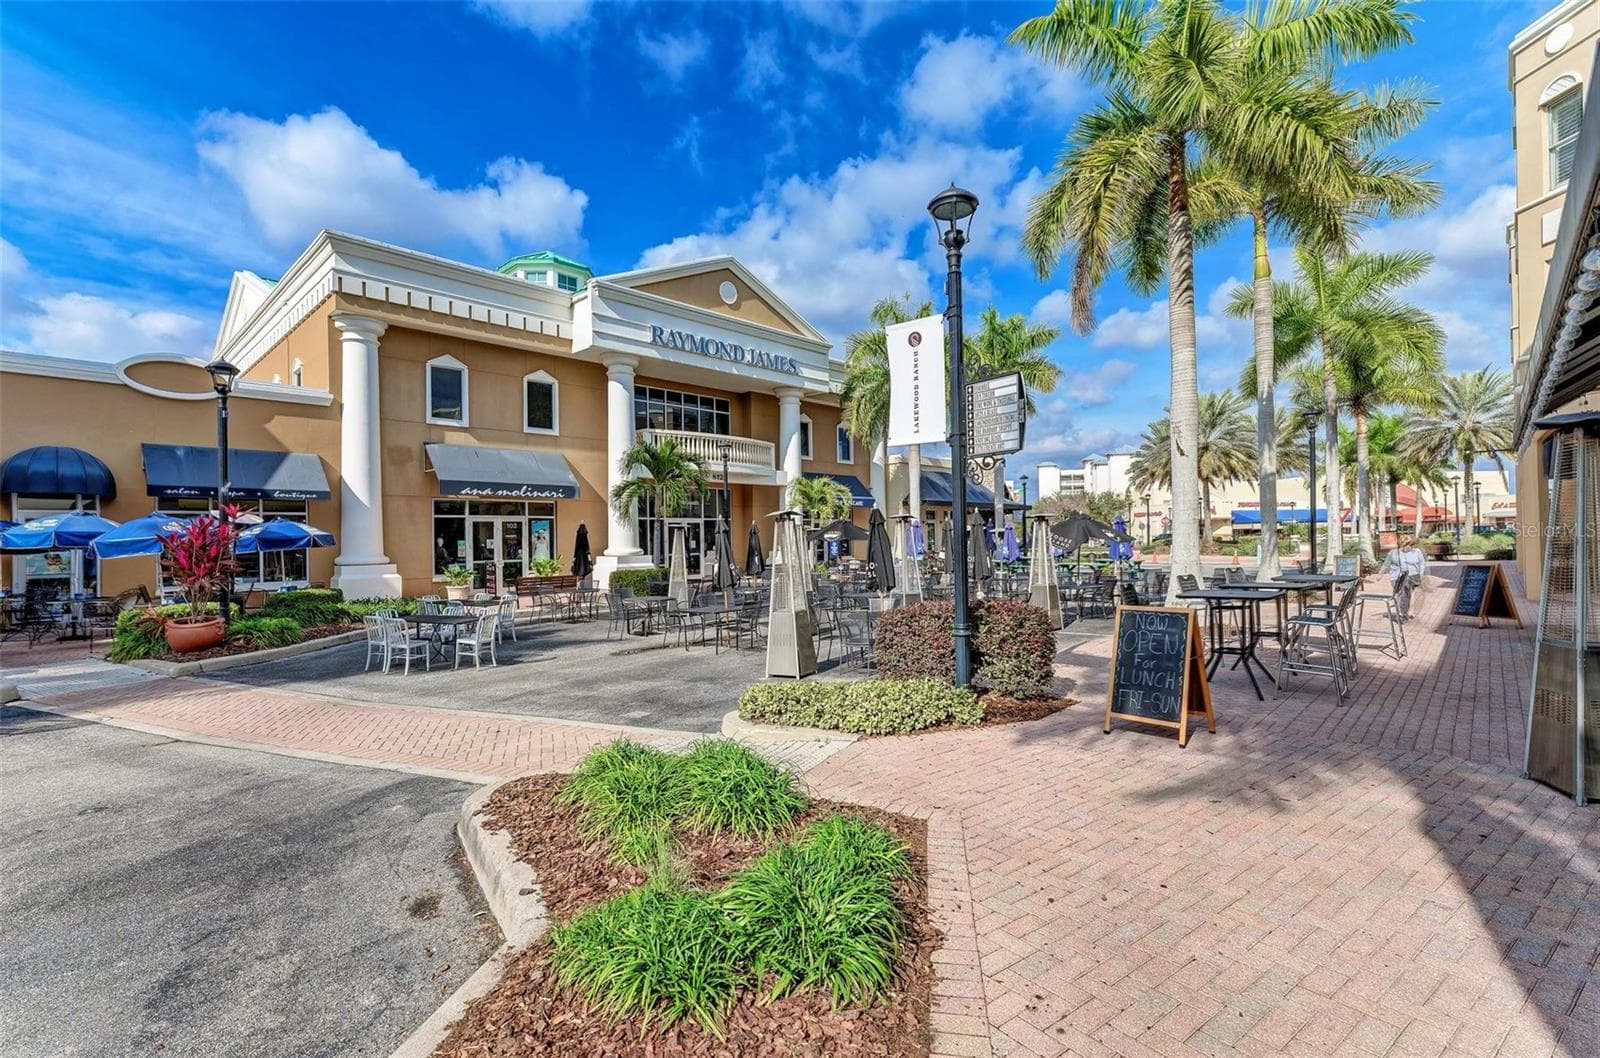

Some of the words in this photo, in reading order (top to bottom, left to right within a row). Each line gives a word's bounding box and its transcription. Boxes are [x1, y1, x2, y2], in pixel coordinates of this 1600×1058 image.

[651, 325, 744, 361] RAYMOND
[747, 348, 798, 374] JAMES
[163, 487, 200, 495] salon
[273, 490, 318, 500] boutique
[460, 487, 493, 495] ana
[495, 485, 565, 498] molinari
[1136, 615, 1168, 631] NOW
[1122, 629, 1179, 655] OPEN
[1134, 653, 1157, 669] For
[1119, 666, 1176, 690] LUNCH
[1118, 688, 1181, 714] FRI-SUN
